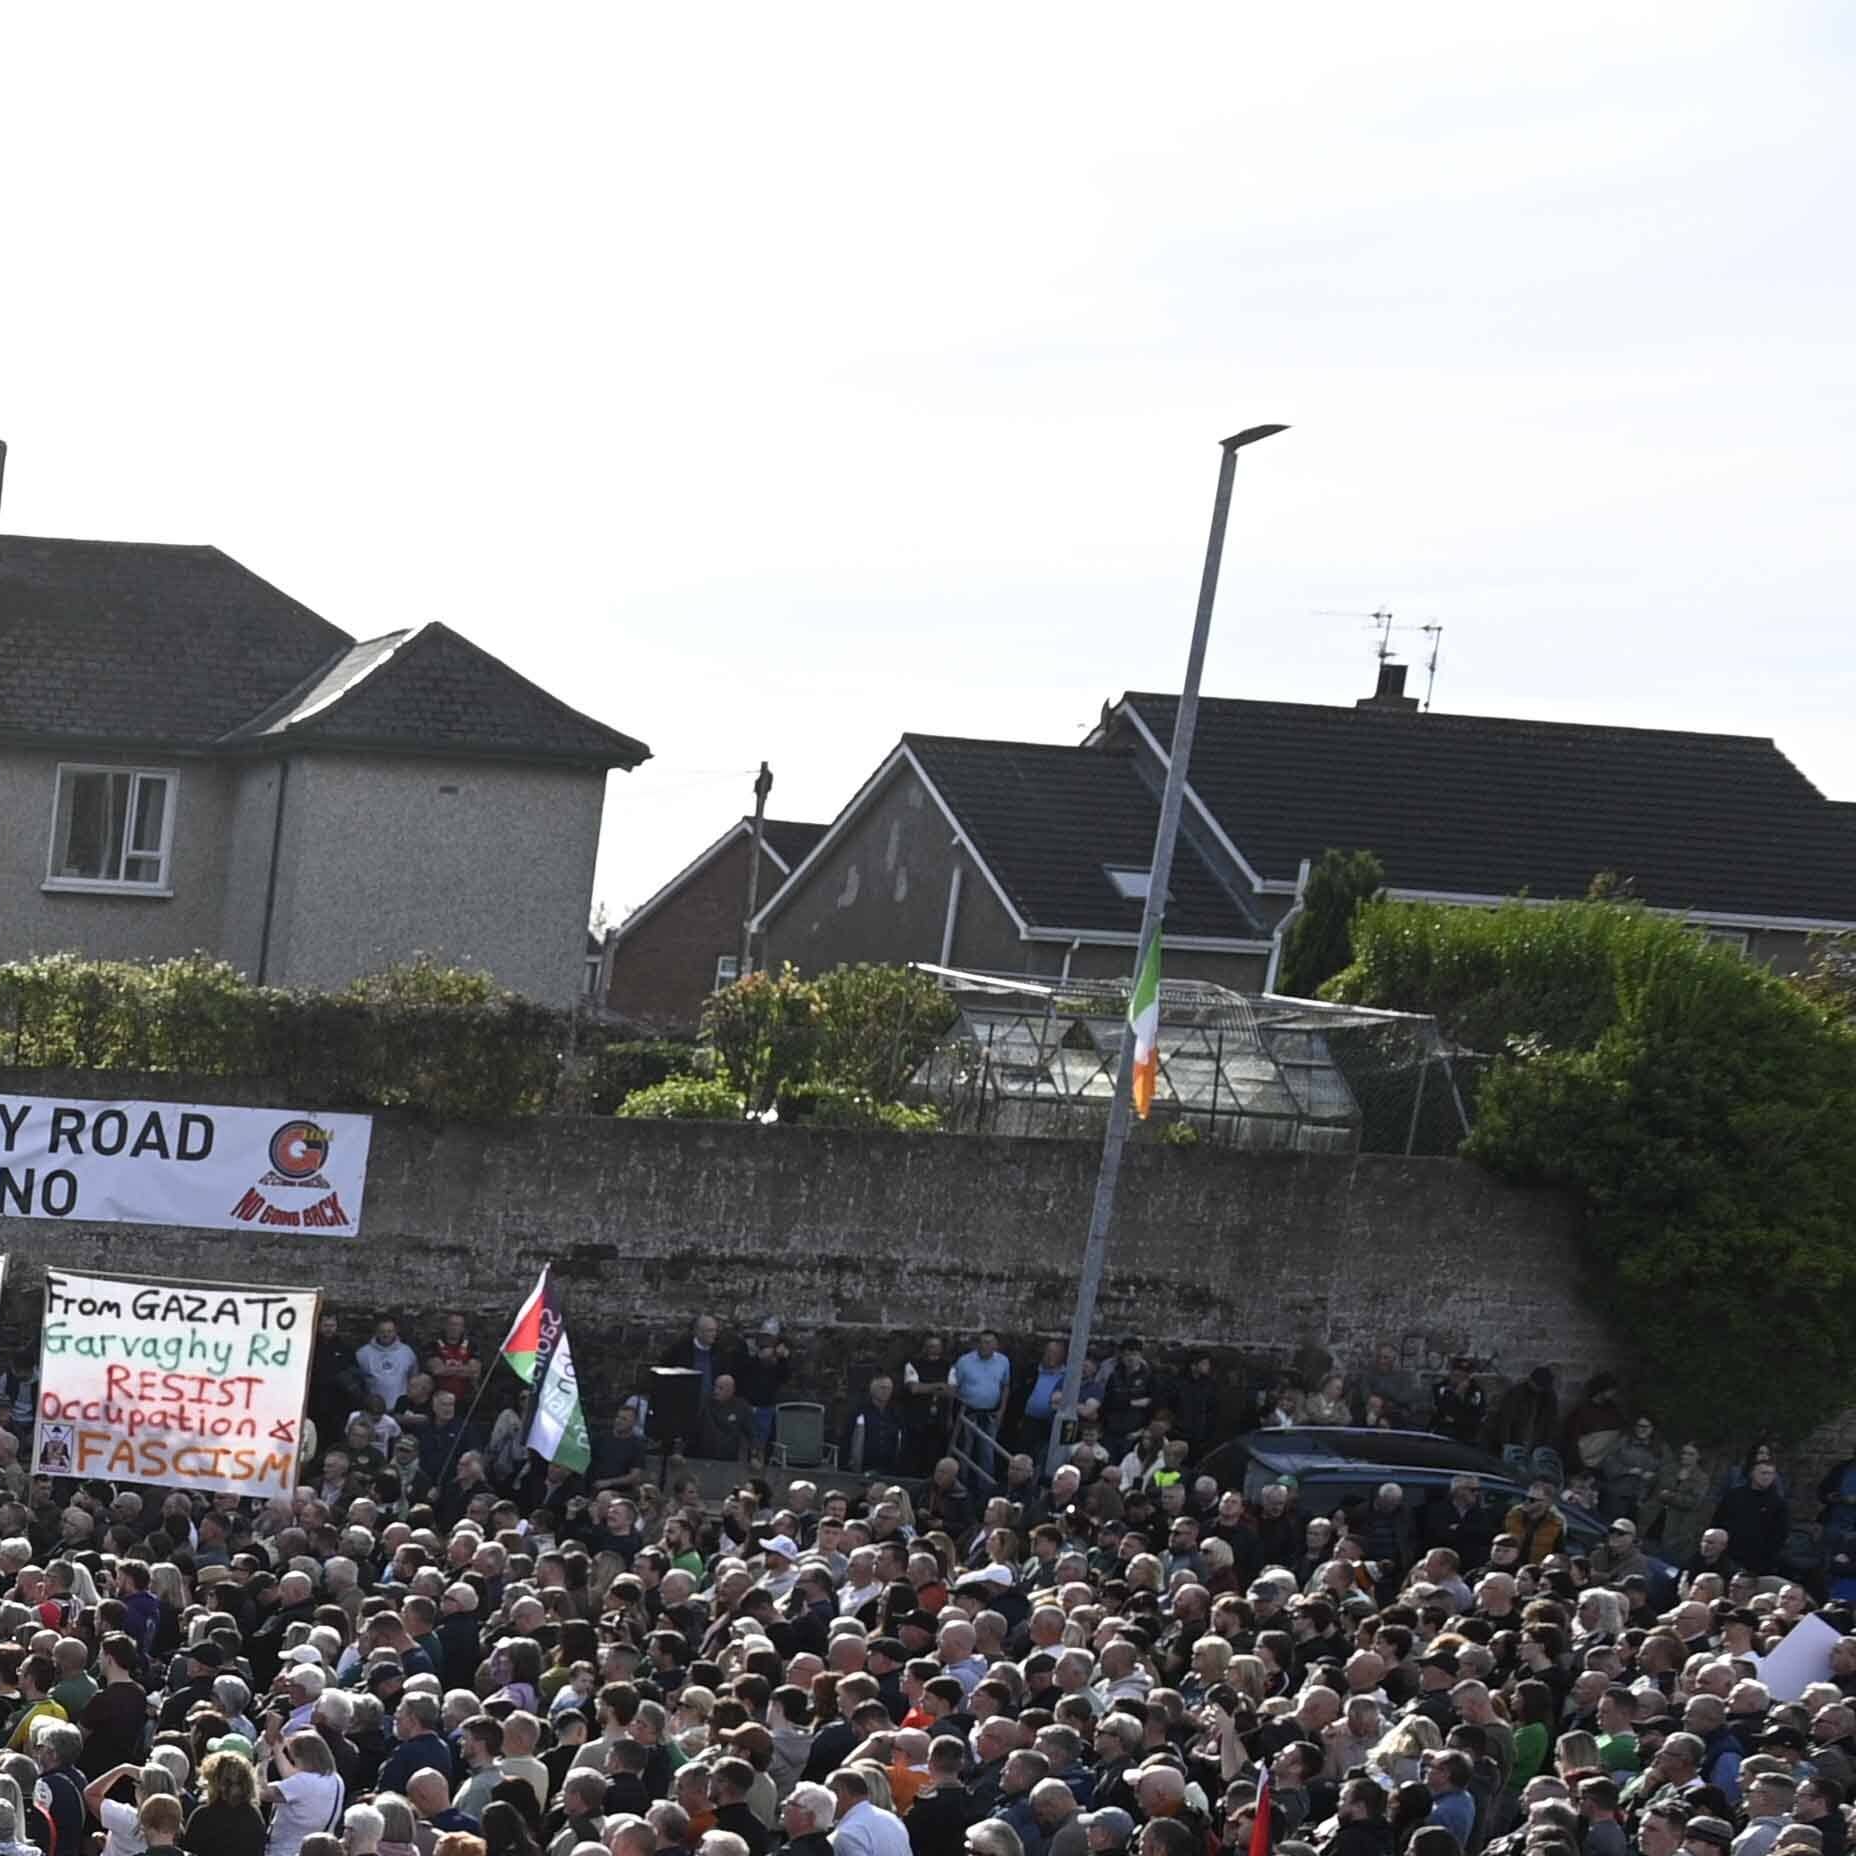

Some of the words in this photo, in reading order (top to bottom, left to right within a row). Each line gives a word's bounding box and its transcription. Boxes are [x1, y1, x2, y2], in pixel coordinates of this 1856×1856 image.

[47, 1107, 215, 1161] ROAD
[230, 1186, 266, 1222] NO
[302, 1191, 350, 1227] BACK
[45, 1277, 121, 1318] From
[132, 1289, 240, 1325] GAZA
[244, 1297, 296, 1330] To
[43, 1322, 232, 1376] Garvaghy
[247, 1334, 291, 1367] Rd
[106, 1364, 265, 1409] RESIST
[41, 1392, 256, 1437] Occupation
[77, 1431, 289, 1488] FASCISM
